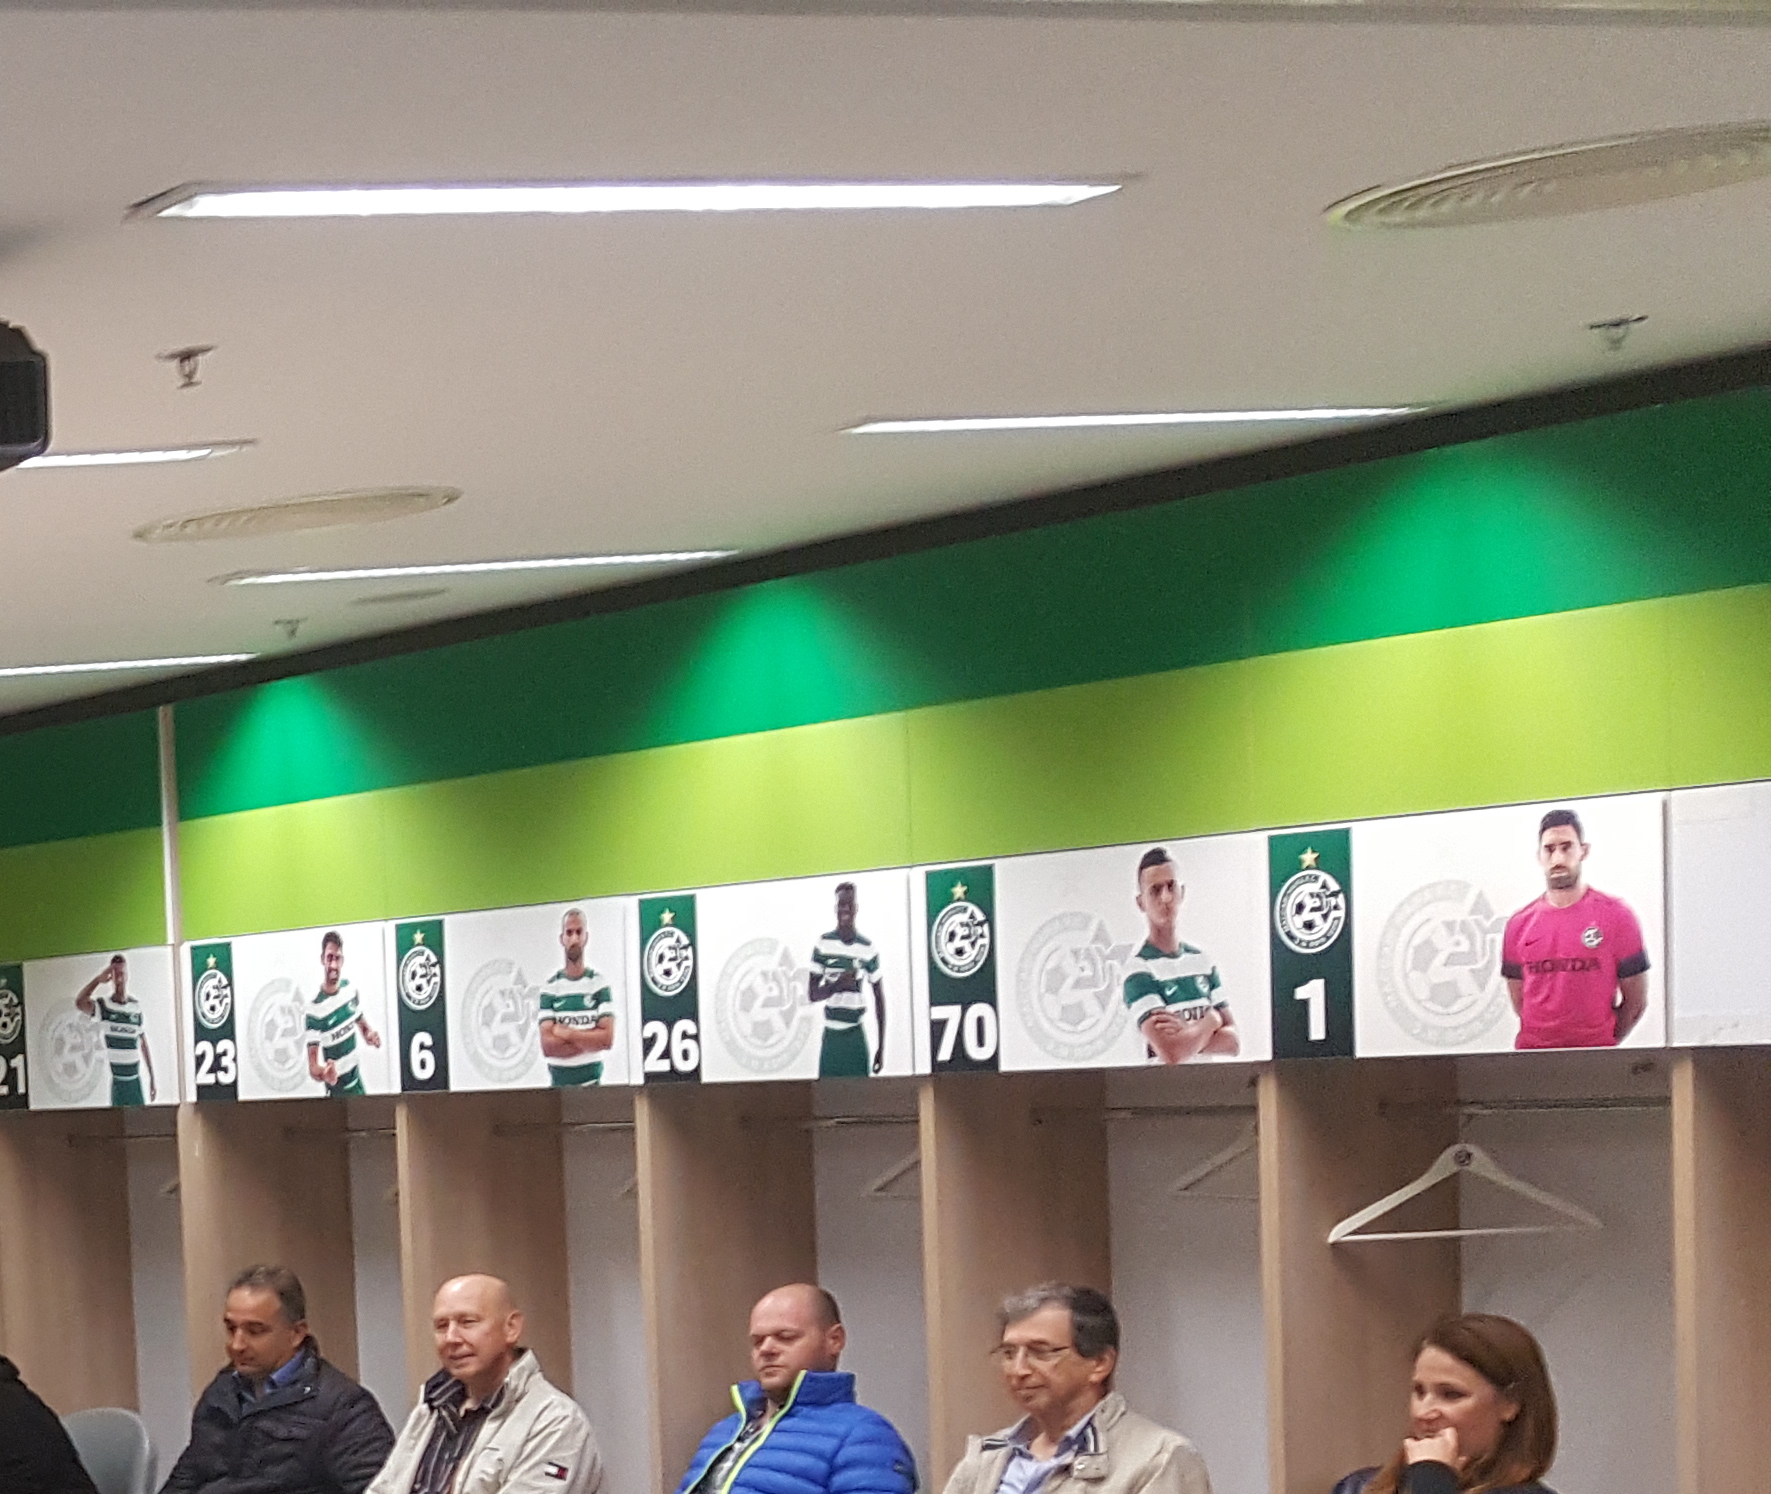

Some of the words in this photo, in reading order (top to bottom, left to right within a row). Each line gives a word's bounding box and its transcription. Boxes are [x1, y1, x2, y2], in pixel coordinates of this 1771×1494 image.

[1526, 957, 1601, 973] HONDA
[930, 1001, 998, 1063] 70
[1294, 978, 1326, 1041] 1
[195, 1038, 237, 1086] 23
[410, 1031, 436, 1081] 6
[642, 1018, 700, 1074] 26
